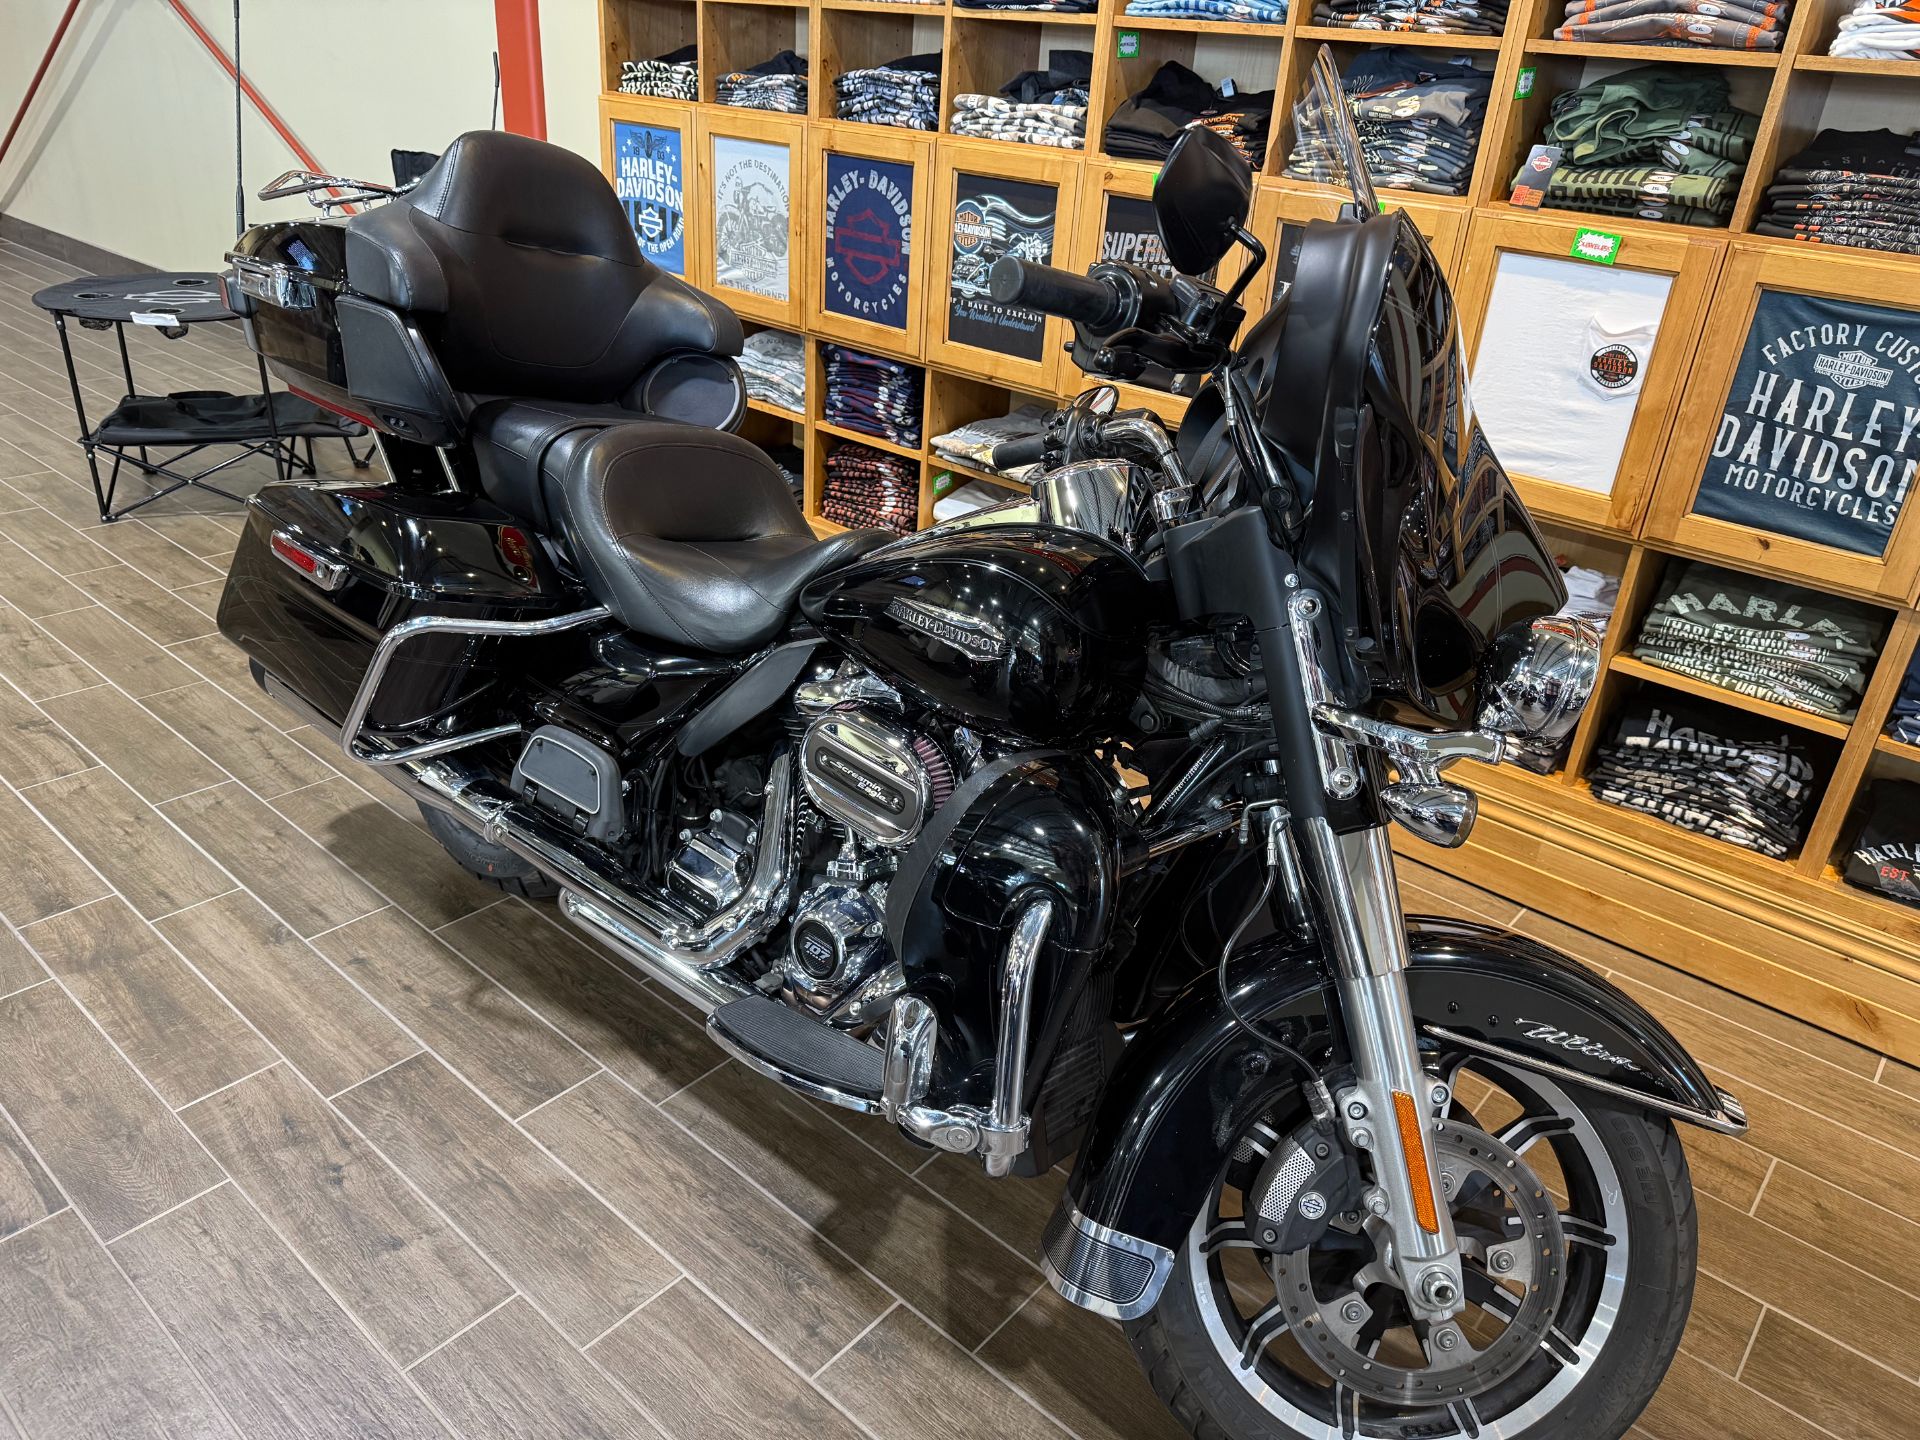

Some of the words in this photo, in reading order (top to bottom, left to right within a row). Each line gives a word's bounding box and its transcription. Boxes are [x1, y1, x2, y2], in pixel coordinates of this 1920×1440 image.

[621, 157, 678, 185] HARLEY-
[717, 181, 727, 200] IT'S
[726, 165, 738, 182] NOT
[738, 159, 752, 170] THE
[616, 177, 684, 212] DAVIDSON
[868, 169, 912, 255] DAVIDSON
[958, 211, 978, 223] MOTOR
[647, 243, 659, 254] THE
[659, 236, 675, 252] OPEN
[736, 280, 750, 292] THE
[752, 283, 787, 301] JOURNEY
[826, 257, 907, 314] MOTORCYCLES
[954, 304, 968, 317] You
[998, 314, 1038, 332] Understand
[968, 301, 988, 312] HAVE
[992, 304, 1002, 314] TO
[1006, 308, 1042, 323] EXPLAIN
[1761, 323, 1869, 366] FACTORY
[1817, 356, 1889, 381] HARLEY-DAVIDSON
[1842, 352, 1874, 366] MOTOR
[1712, 413, 1918, 504] DAVIDSON
[1724, 463, 1898, 526] MOTORCYCLES
[891, 603, 1001, 655] HARLEY-DAVIDSON
[803, 941, 831, 960] 107
